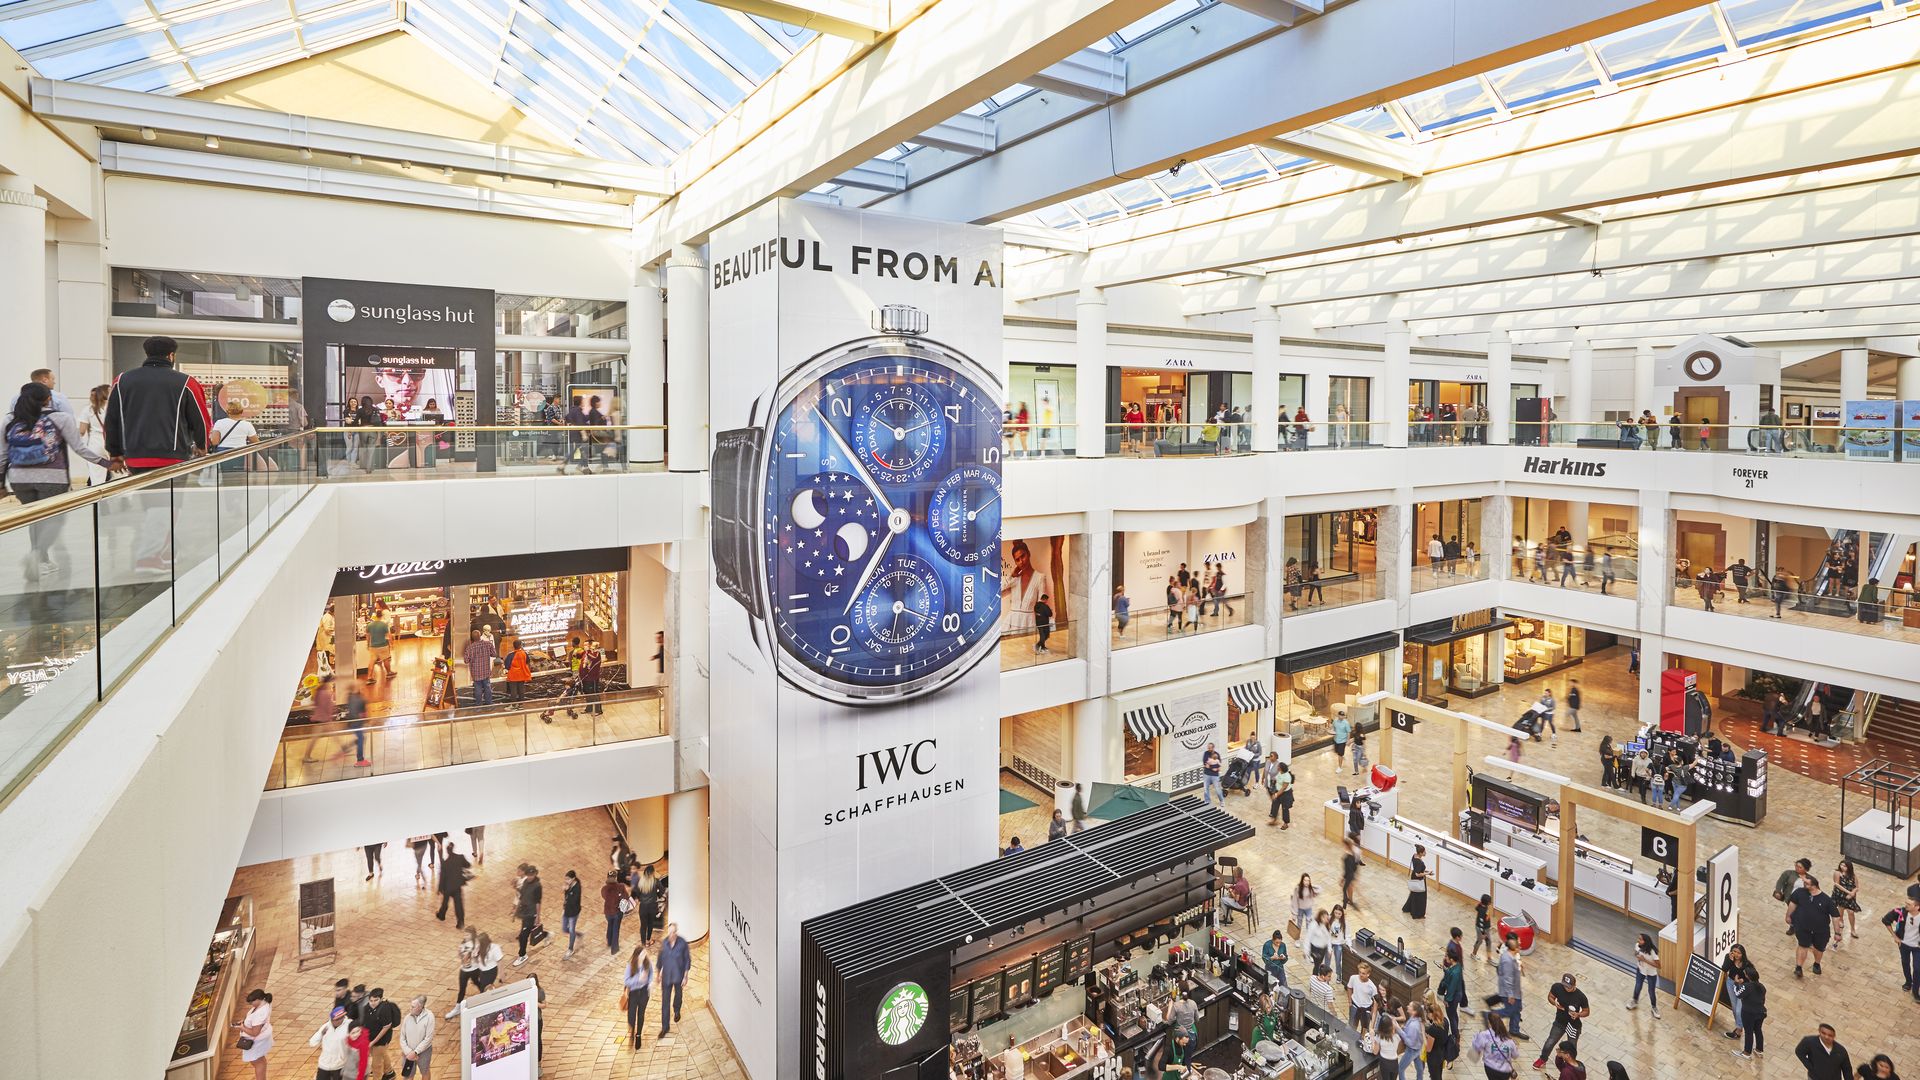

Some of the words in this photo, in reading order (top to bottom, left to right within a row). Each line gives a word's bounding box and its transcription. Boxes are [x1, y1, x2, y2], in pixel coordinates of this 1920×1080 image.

[714, 237, 832, 289] BEAUTIFUL
[852, 245, 957, 284] FROM
[974, 260, 1004, 288] A
[360, 304, 440, 324] sunglass
[445, 306, 475, 324] hut
[382, 358, 420, 366] sunglass
[420, 356, 434, 364] hut
[1165, 358, 1193, 367] ZARA
[832, 398, 852, 417] 2
[945, 404, 962, 423] 4
[869, 422, 878, 448] DAYS
[984, 446, 1000, 464] 5
[1524, 456, 1606, 478] Harkins
[1732, 468, 1768, 479] FOREVER
[946, 474, 961, 487] FEB
[982, 473, 996, 485] APR
[1745, 479, 1754, 488] 21
[938, 488, 947, 505] JAN
[949, 501, 960, 531] IWC
[934, 532, 947, 548] NOV
[946, 547, 961, 560] OCT
[964, 553, 979, 561] SEP
[981, 542, 995, 557] AUG
[1204, 552, 1236, 562] ZARA
[898, 559, 916, 569] TUE
[983, 567, 998, 582] 7
[925, 572, 938, 596] WED
[964, 576, 973, 610] 2020
[789, 593, 810, 613] 11
[511, 608, 576, 626] APOTHECARY
[926, 610, 939, 632] THU
[943, 613, 960, 632] 8
[831, 624, 850, 653] 10
[865, 638, 882, 653] SAT
[899, 642, 915, 654] FRI
[1174, 728, 1197, 738] COOKING
[1197, 722, 1217, 732] CLASSES
[856, 738, 937, 791] IWC
[824, 779, 965, 826] SCHAFFHAUSEN
[731, 900, 750, 946] IWC
[724, 920, 758, 975] SCHAFFHAUSEN
[1715, 928, 1736, 958] b8ta
[1693, 959, 1715, 975] Welcome,
